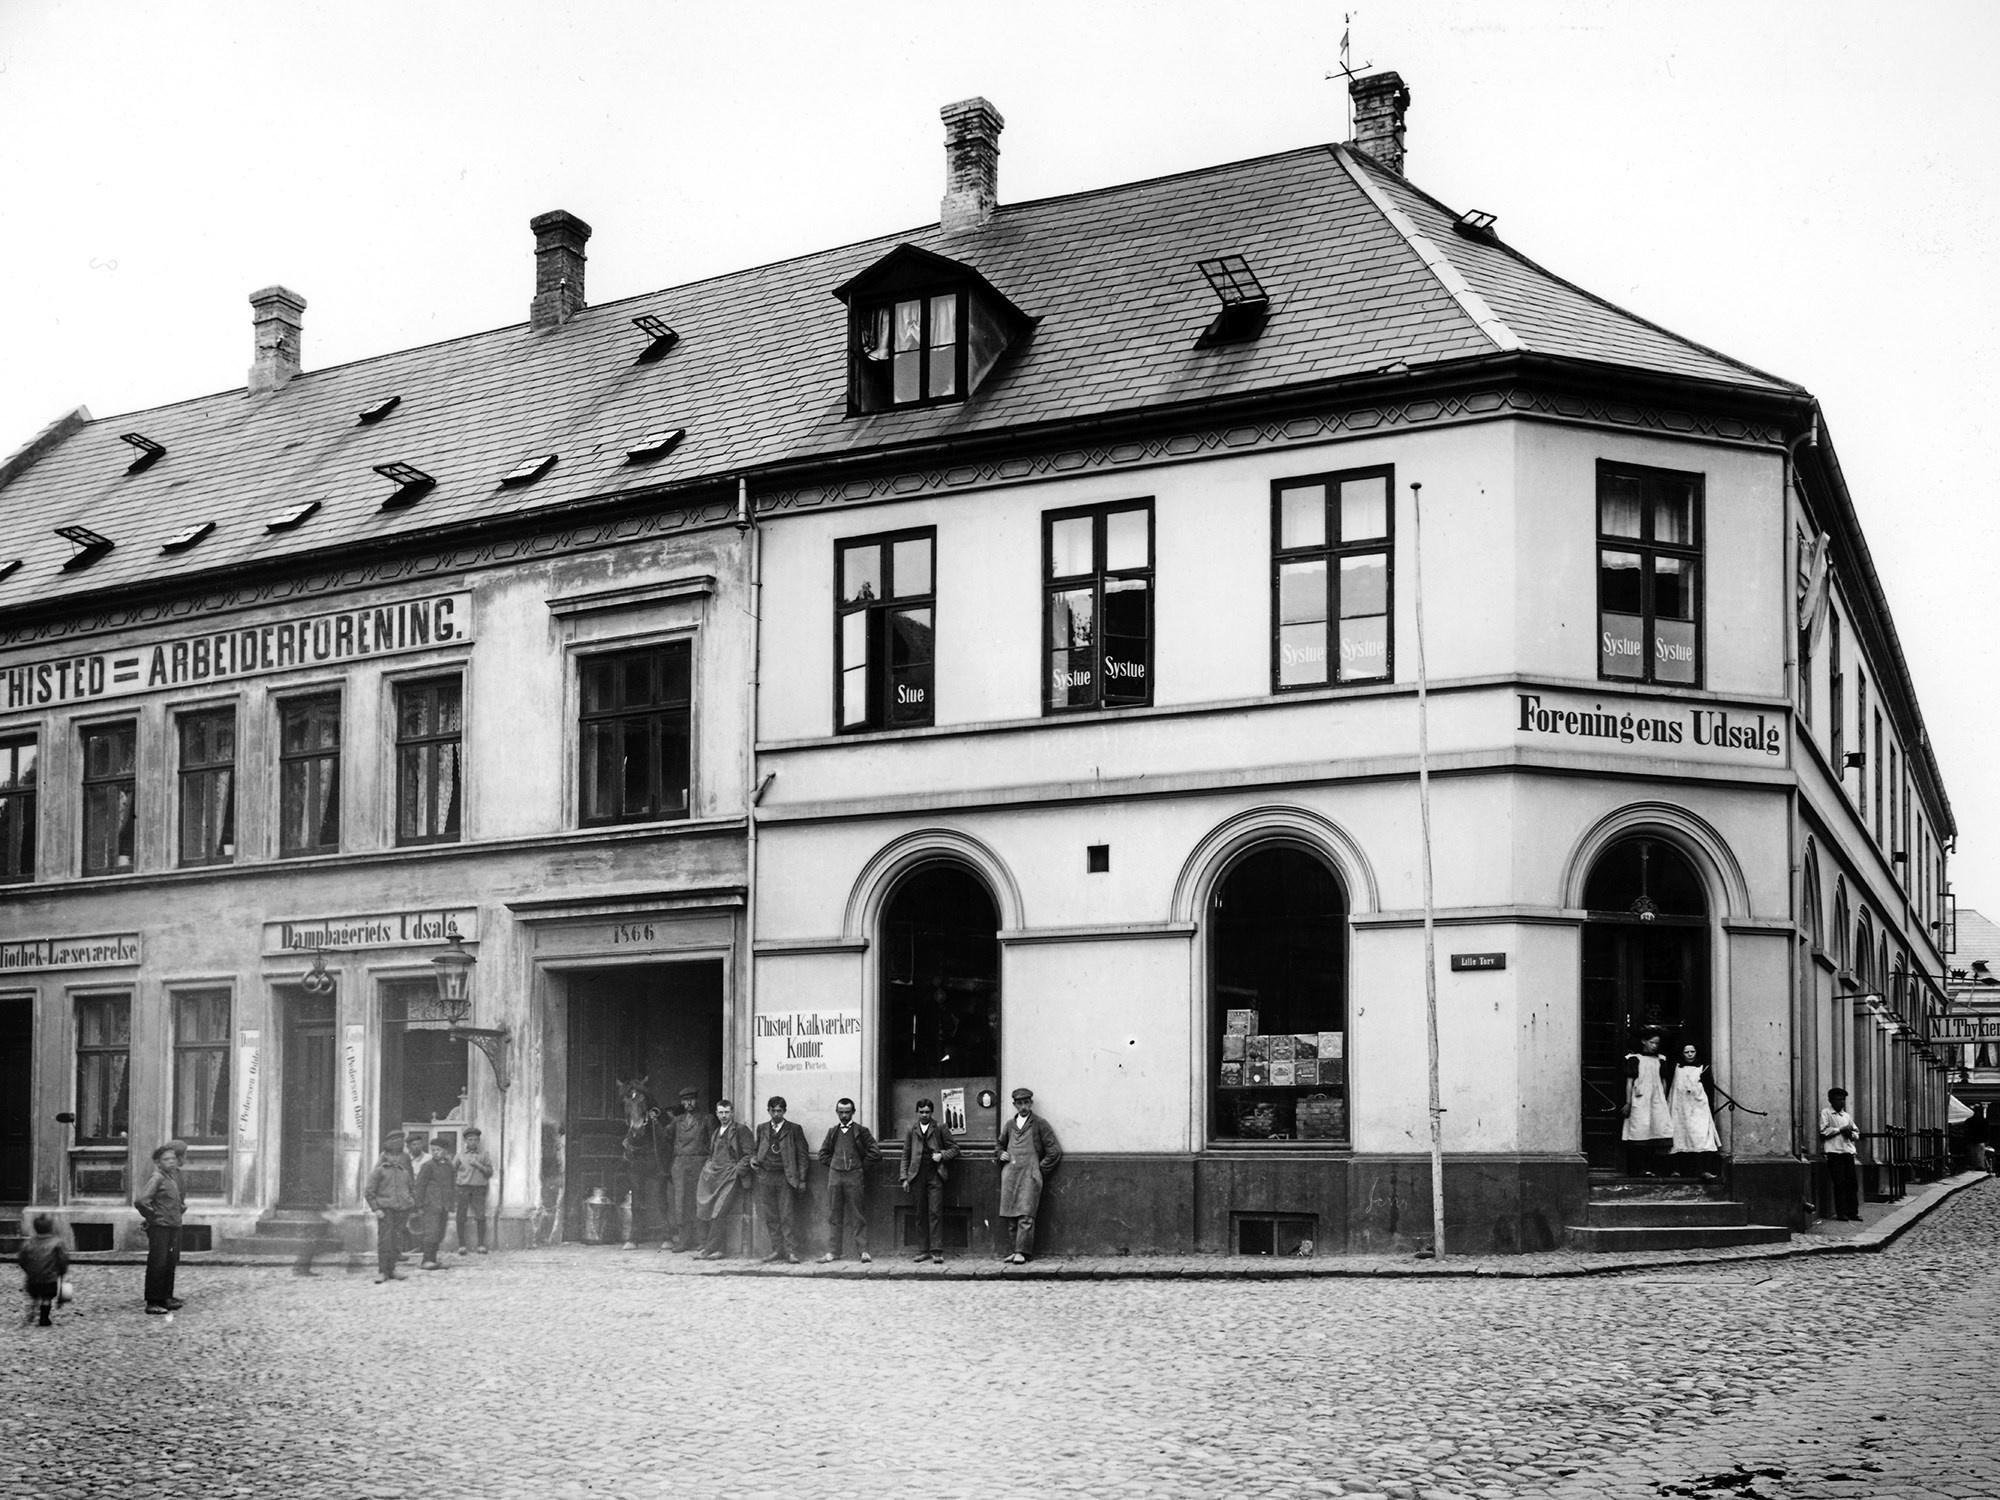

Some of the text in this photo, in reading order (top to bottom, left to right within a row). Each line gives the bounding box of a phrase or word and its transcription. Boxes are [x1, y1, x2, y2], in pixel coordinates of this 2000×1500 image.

[1282, 643, 1325, 667] Systue
[1341, 638, 1385, 662] Systue
[1603, 631, 1641, 657] Systue
[1656, 637, 1693, 662] Systue
[1053, 668, 1091, 690] Systue
[1105, 655, 1145, 679] Systue
[897, 684, 924, 704] Stue
[1517, 694, 1780, 756] Foreningens Udsalg
[281, 921, 392, 950] Dampbageriets
[1461, 956, 1495, 966] Lille Torv
[755, 1014, 792, 1037] Thisted
[787, 1036, 824, 1059] Kontor.
